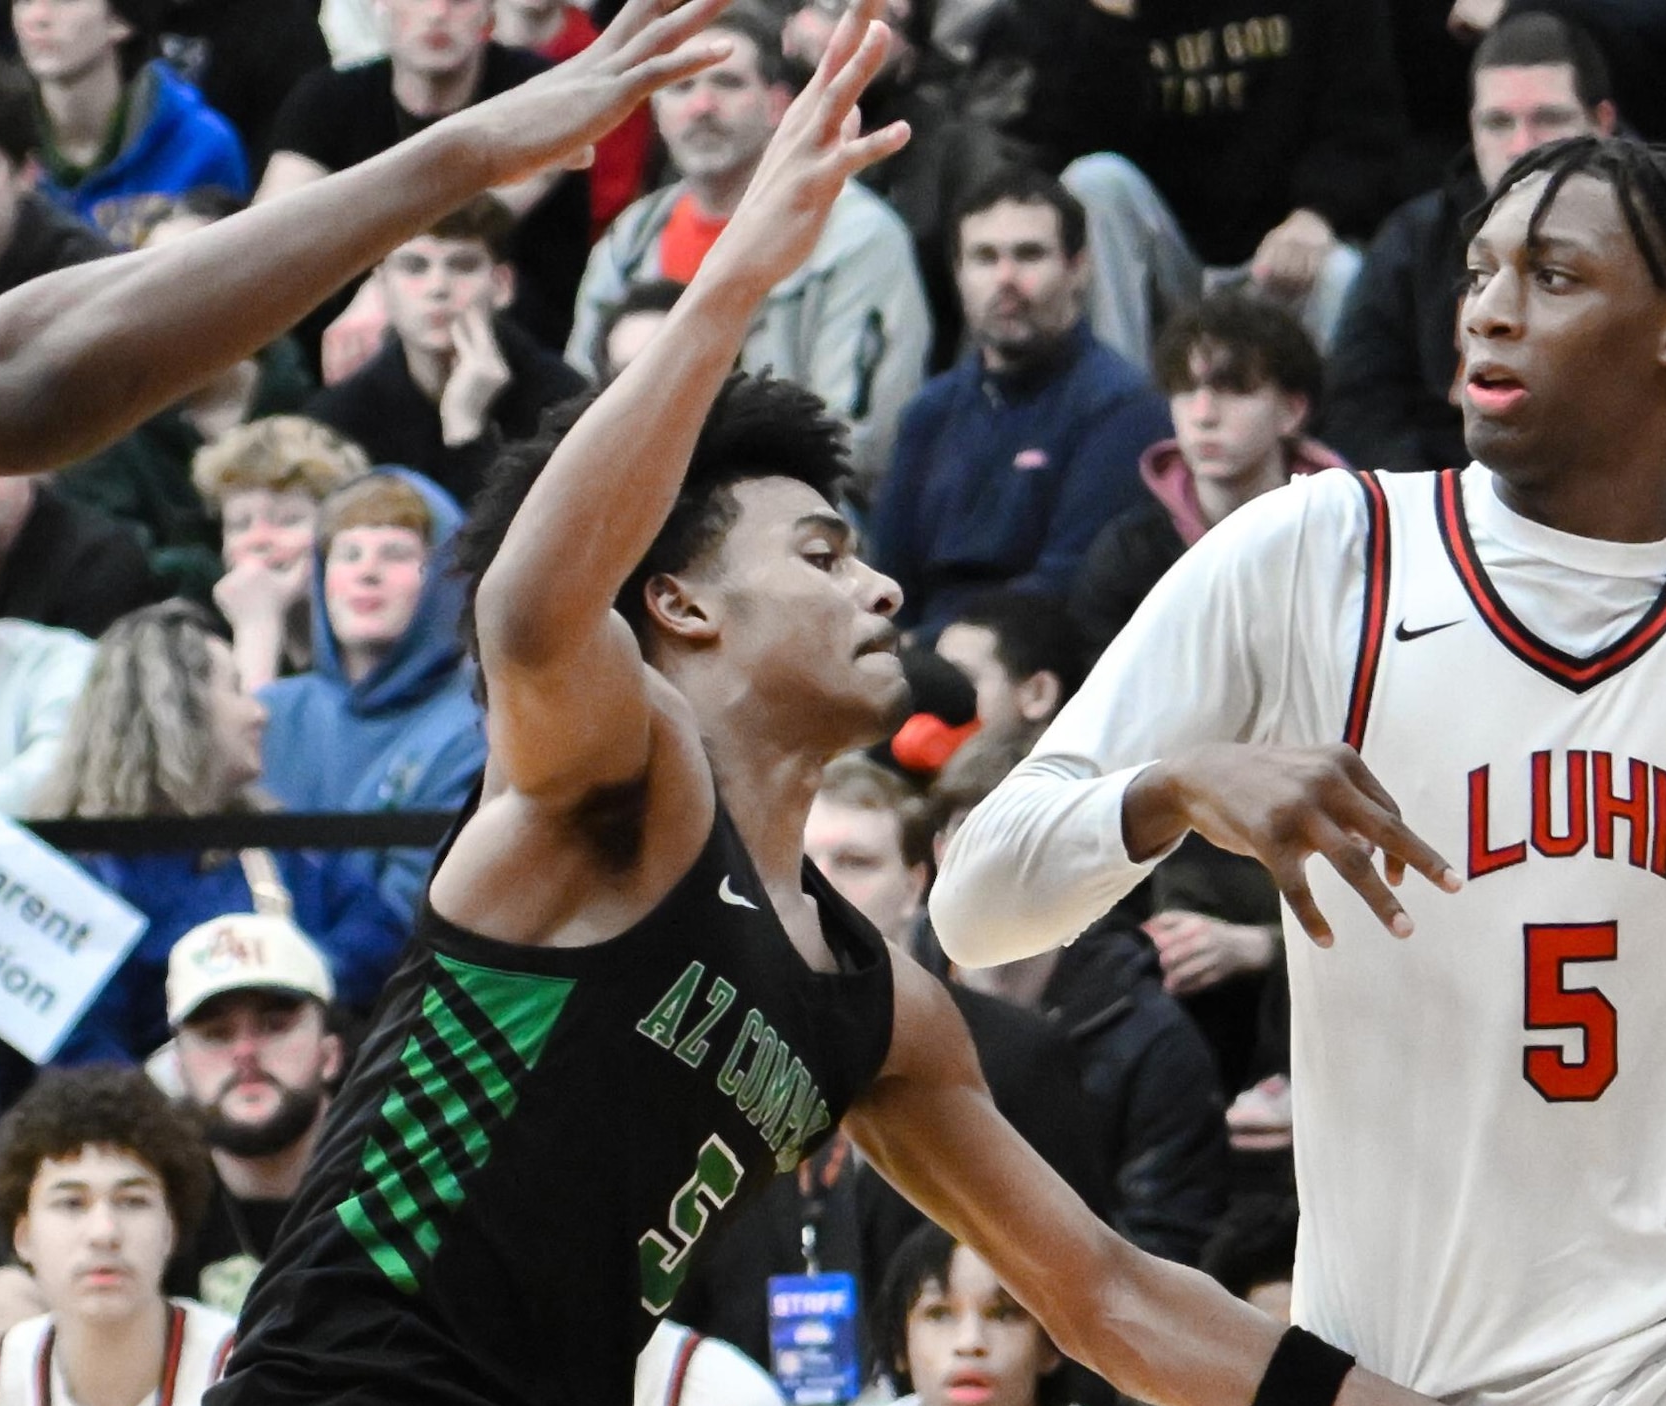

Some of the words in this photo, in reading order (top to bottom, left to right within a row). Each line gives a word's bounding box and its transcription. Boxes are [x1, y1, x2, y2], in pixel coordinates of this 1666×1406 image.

[635, 959, 738, 1069] AZ
[1523, 919, 1619, 1103] 5
[637, 1132, 745, 1317] 5
